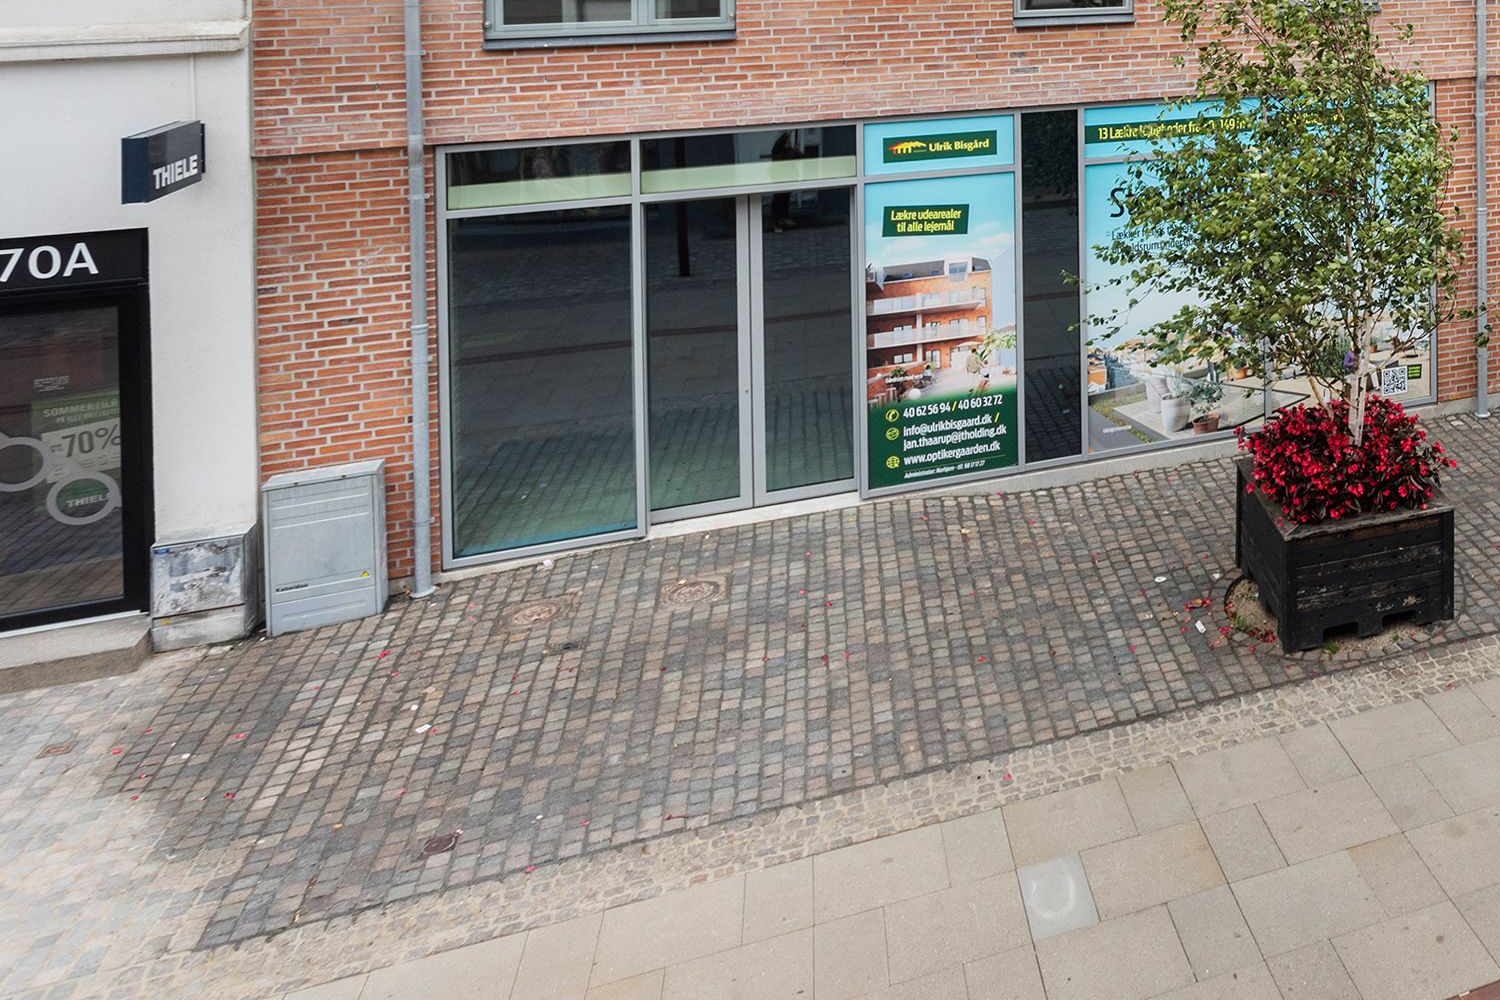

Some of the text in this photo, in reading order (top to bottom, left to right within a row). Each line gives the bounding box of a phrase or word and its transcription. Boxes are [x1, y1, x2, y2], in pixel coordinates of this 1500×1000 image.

[1099, 127, 1108, 140] 13
[929, 139, 990, 152] Ulrik Bisgård
[153, 154, 198, 189] THIELE
[891, 208, 962, 221] Lækre udearealer
[897, 220, 954, 233] til alle lejemål
[0, 242, 99, 282] 70A
[903, 407, 915, 418] 40
[916, 406, 926, 416] 62
[928, 404, 938, 415] 56
[940, 403, 951, 413] 94
[958, 399, 969, 410] 40
[971, 398, 981, 408] 60
[983, 396, 992, 406] 32
[994, 394, 1003, 405] 72
[903, 414, 993, 437] info@ulrikbisgaard.dk
[903, 424, 1007, 451] jan.thaarup@jtholding.dk
[904, 440, 1001, 466] www.optikergaarden.dk
